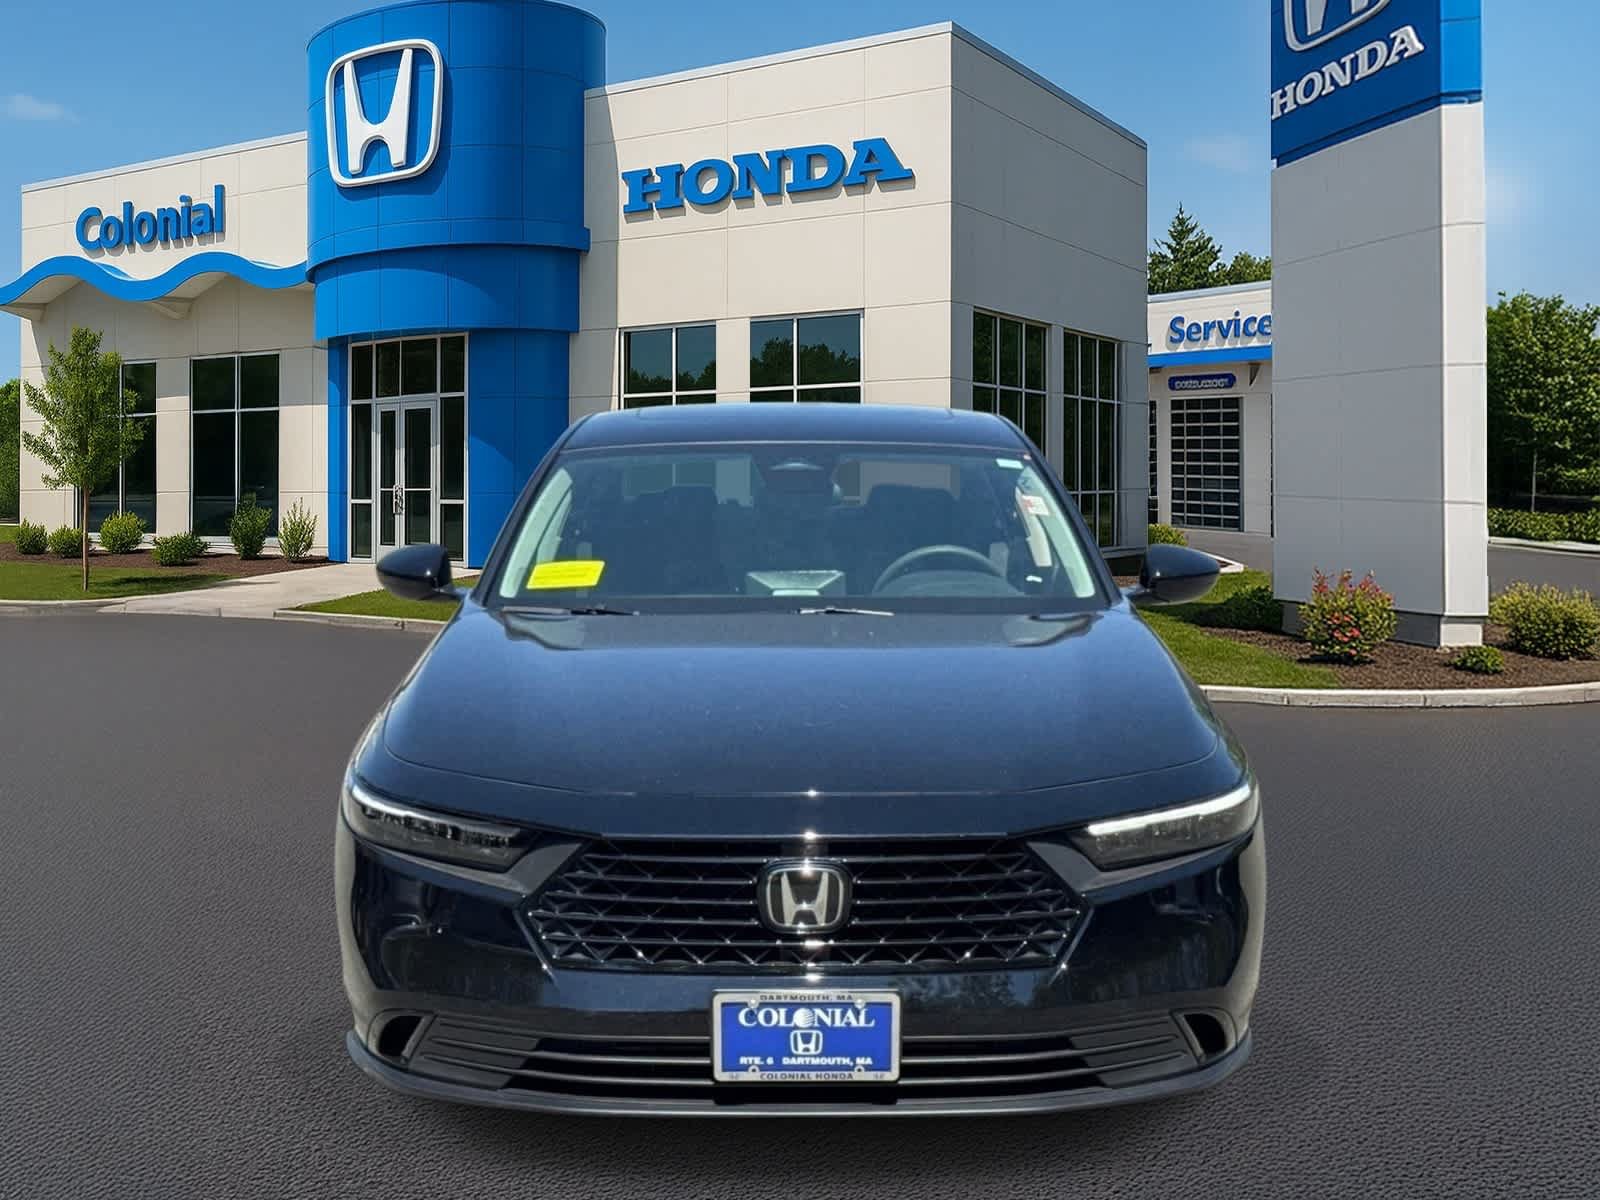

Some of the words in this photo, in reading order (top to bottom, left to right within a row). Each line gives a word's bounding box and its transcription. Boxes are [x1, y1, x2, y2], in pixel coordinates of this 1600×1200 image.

[1271, 25, 1425, 120] HONDA
[622, 137, 914, 214] HONDA
[76, 184, 226, 251] Colonial
[1169, 310, 1272, 344] Service
[738, 1007, 876, 1028] COLONIAL
[740, 1056, 764, 1065] RTE.
[766, 1056, 774, 1065] 6
[782, 1057, 853, 1066] DARTMOUTH,
[856, 1057, 873, 1065] MA
[760, 1072, 812, 1080] COLONIAL
[815, 1072, 853, 1080] HONDA
